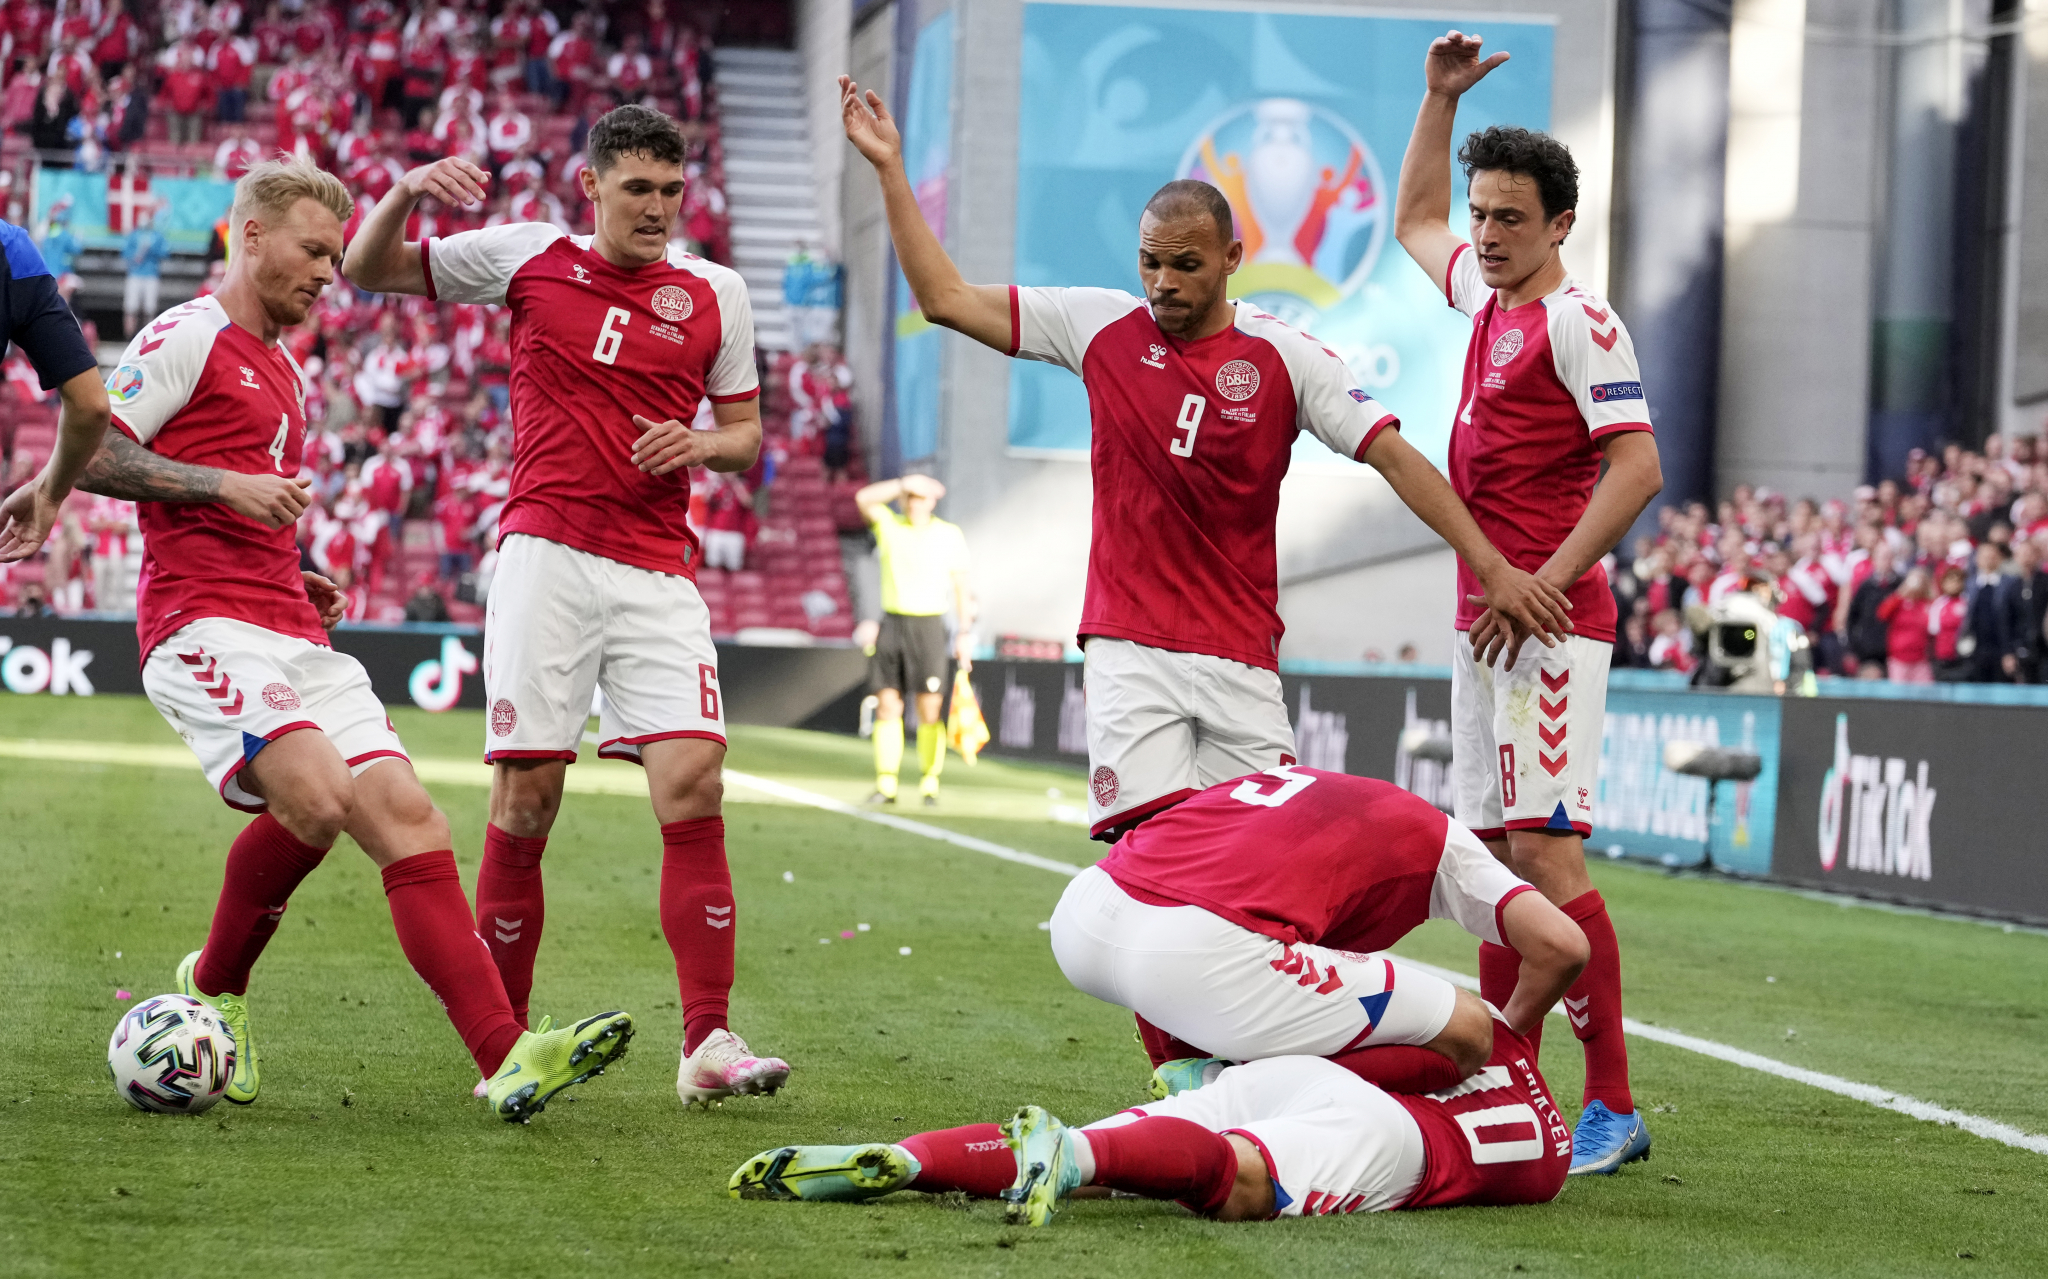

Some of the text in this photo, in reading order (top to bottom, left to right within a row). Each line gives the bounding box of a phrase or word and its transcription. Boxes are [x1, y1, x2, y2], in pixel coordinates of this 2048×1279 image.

[660, 297, 684, 311] DBU
[592, 306, 631, 365] 6
[1140, 355, 1166, 370] hummel
[1225, 373, 1251, 387] DBU
[1607, 386, 1641, 397] RESPECT
[268, 412, 289, 473] 4
[1169, 393, 1206, 458] 9
[0, 634, 95, 697] ok
[698, 662, 719, 722] 6
[1499, 743, 1517, 808] 8
[1846, 754, 1937, 883] TikTok
[1424, 1065, 1545, 1165] 10
